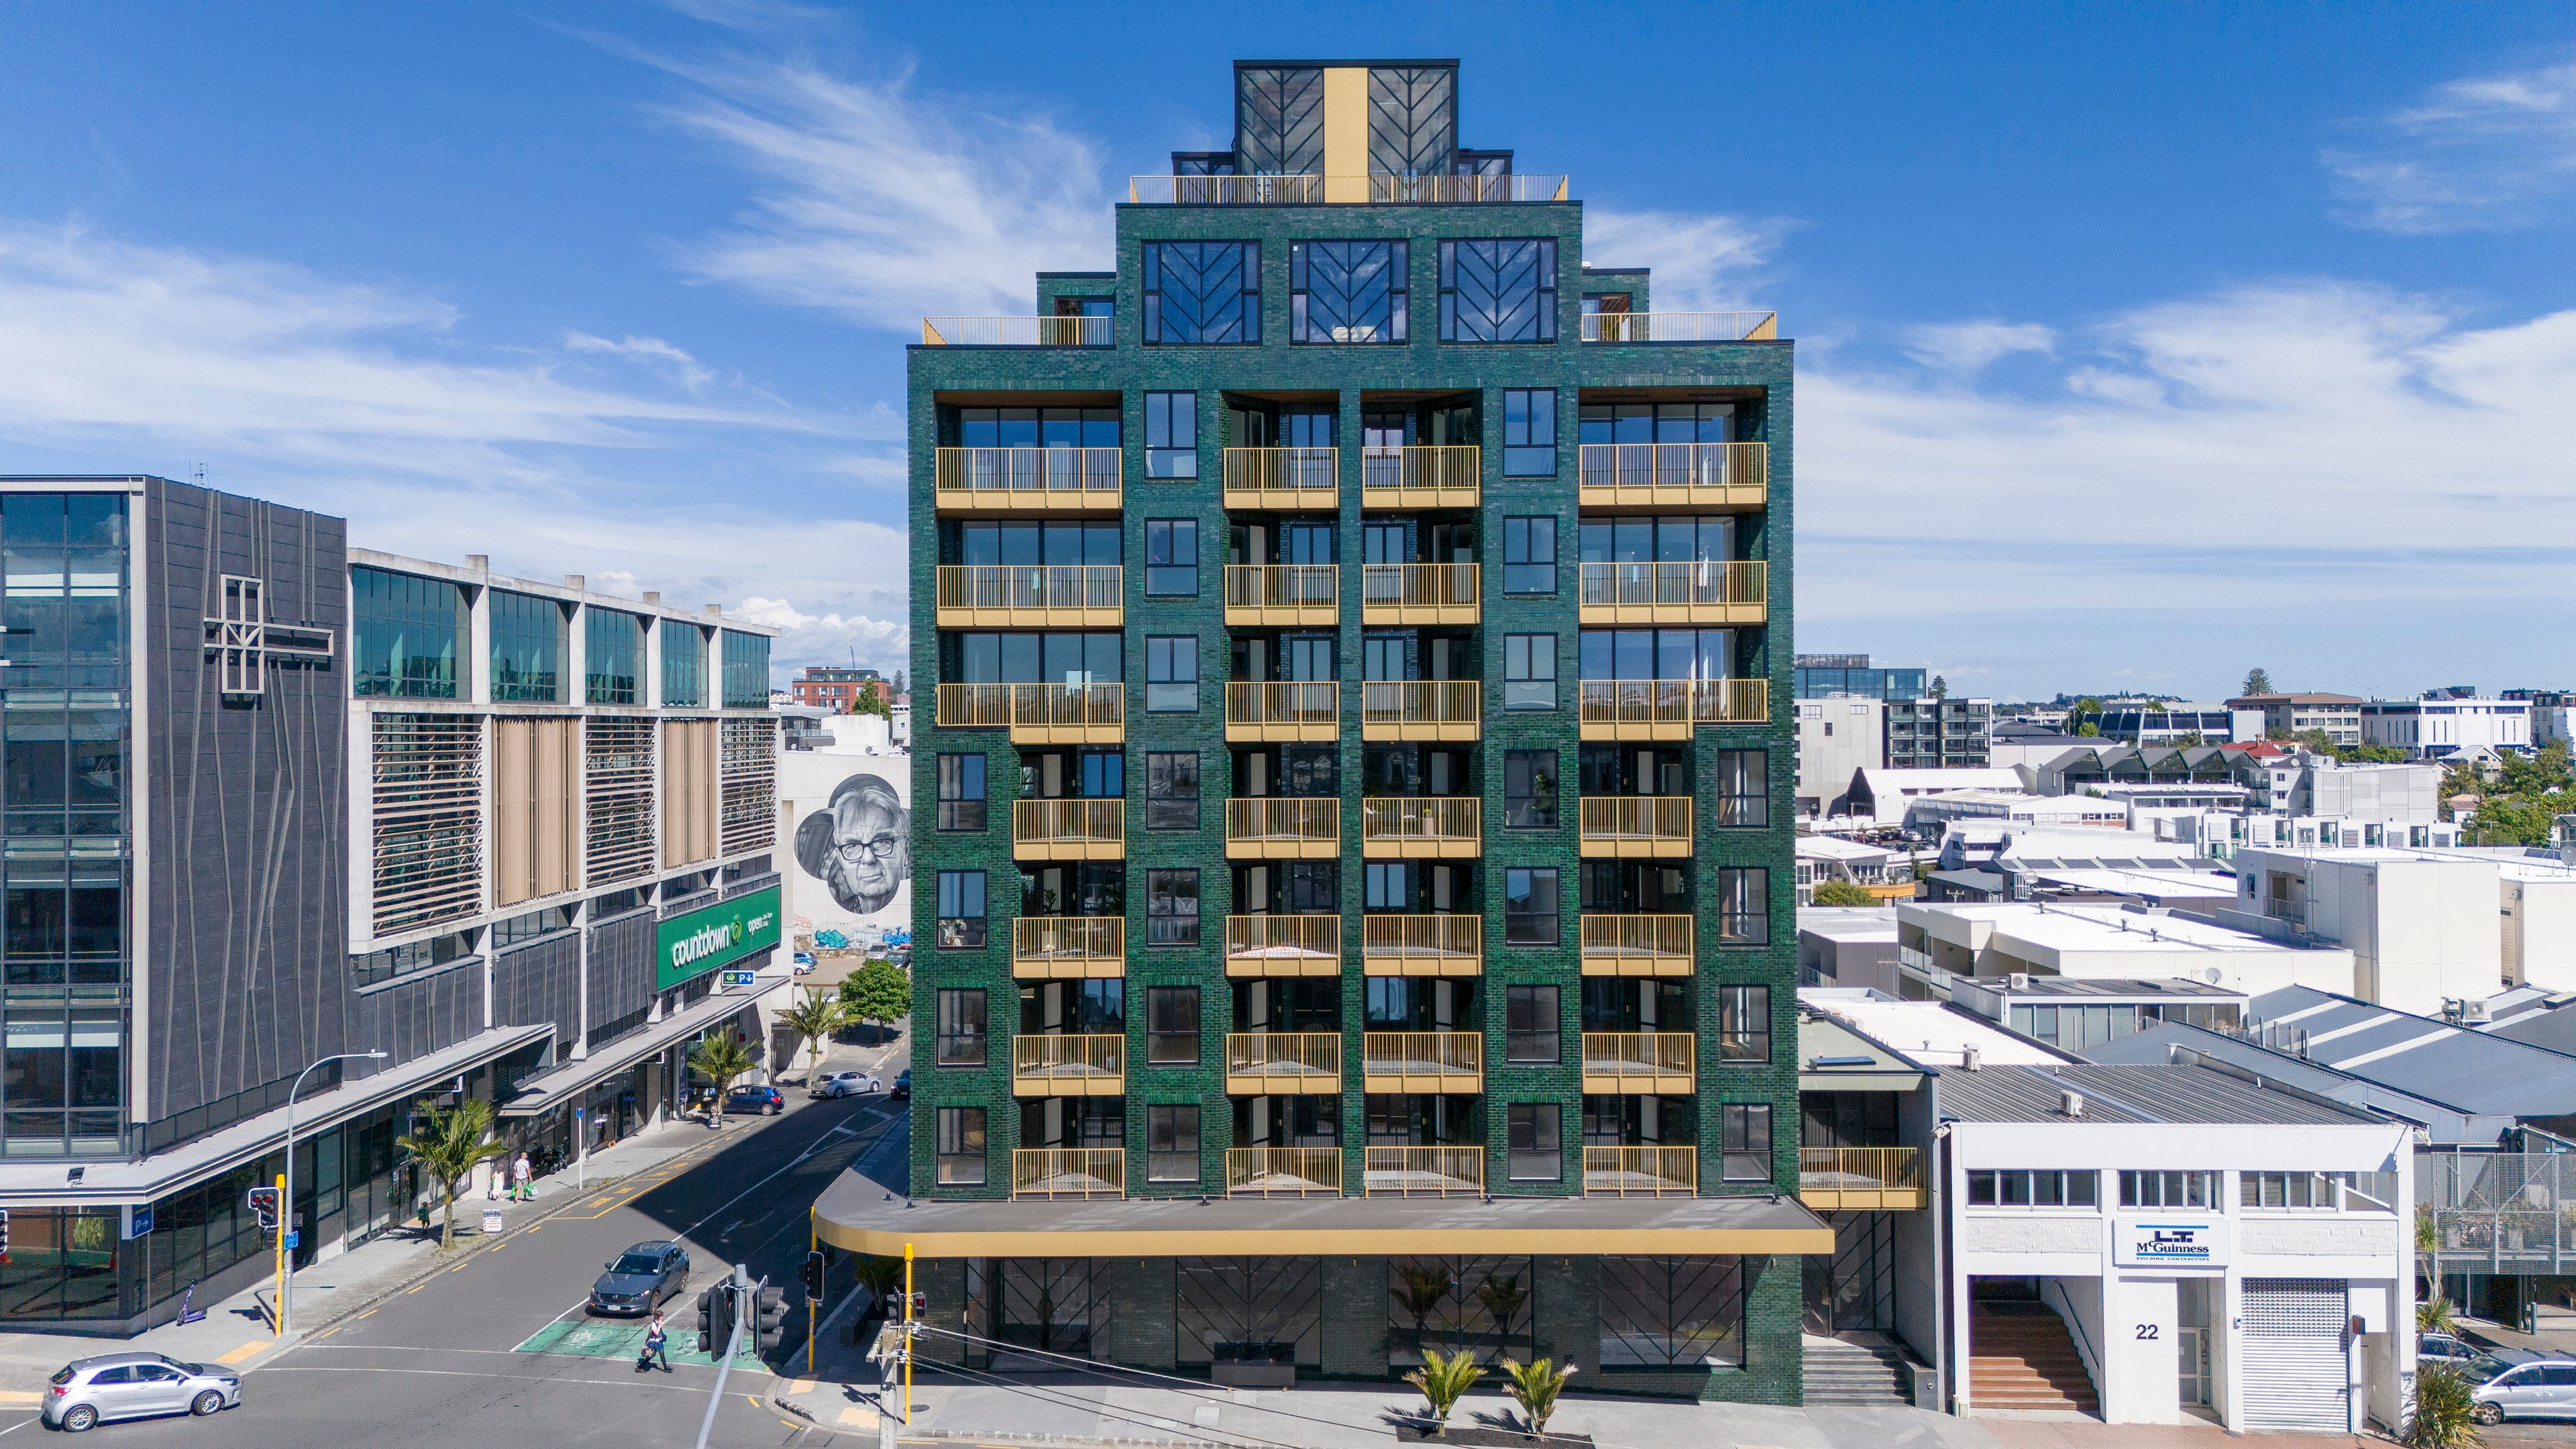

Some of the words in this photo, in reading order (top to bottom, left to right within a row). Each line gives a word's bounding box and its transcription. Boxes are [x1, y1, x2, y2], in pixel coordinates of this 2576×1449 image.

[748, 917, 762, 936] open
[673, 924, 729, 967] countdown
[739, 974, 746, 983] P
[136, 1220, 142, 1233] P
[2137, 1240, 2209, 1252] McGuinness
[2135, 1324, 2158, 1340] 22
